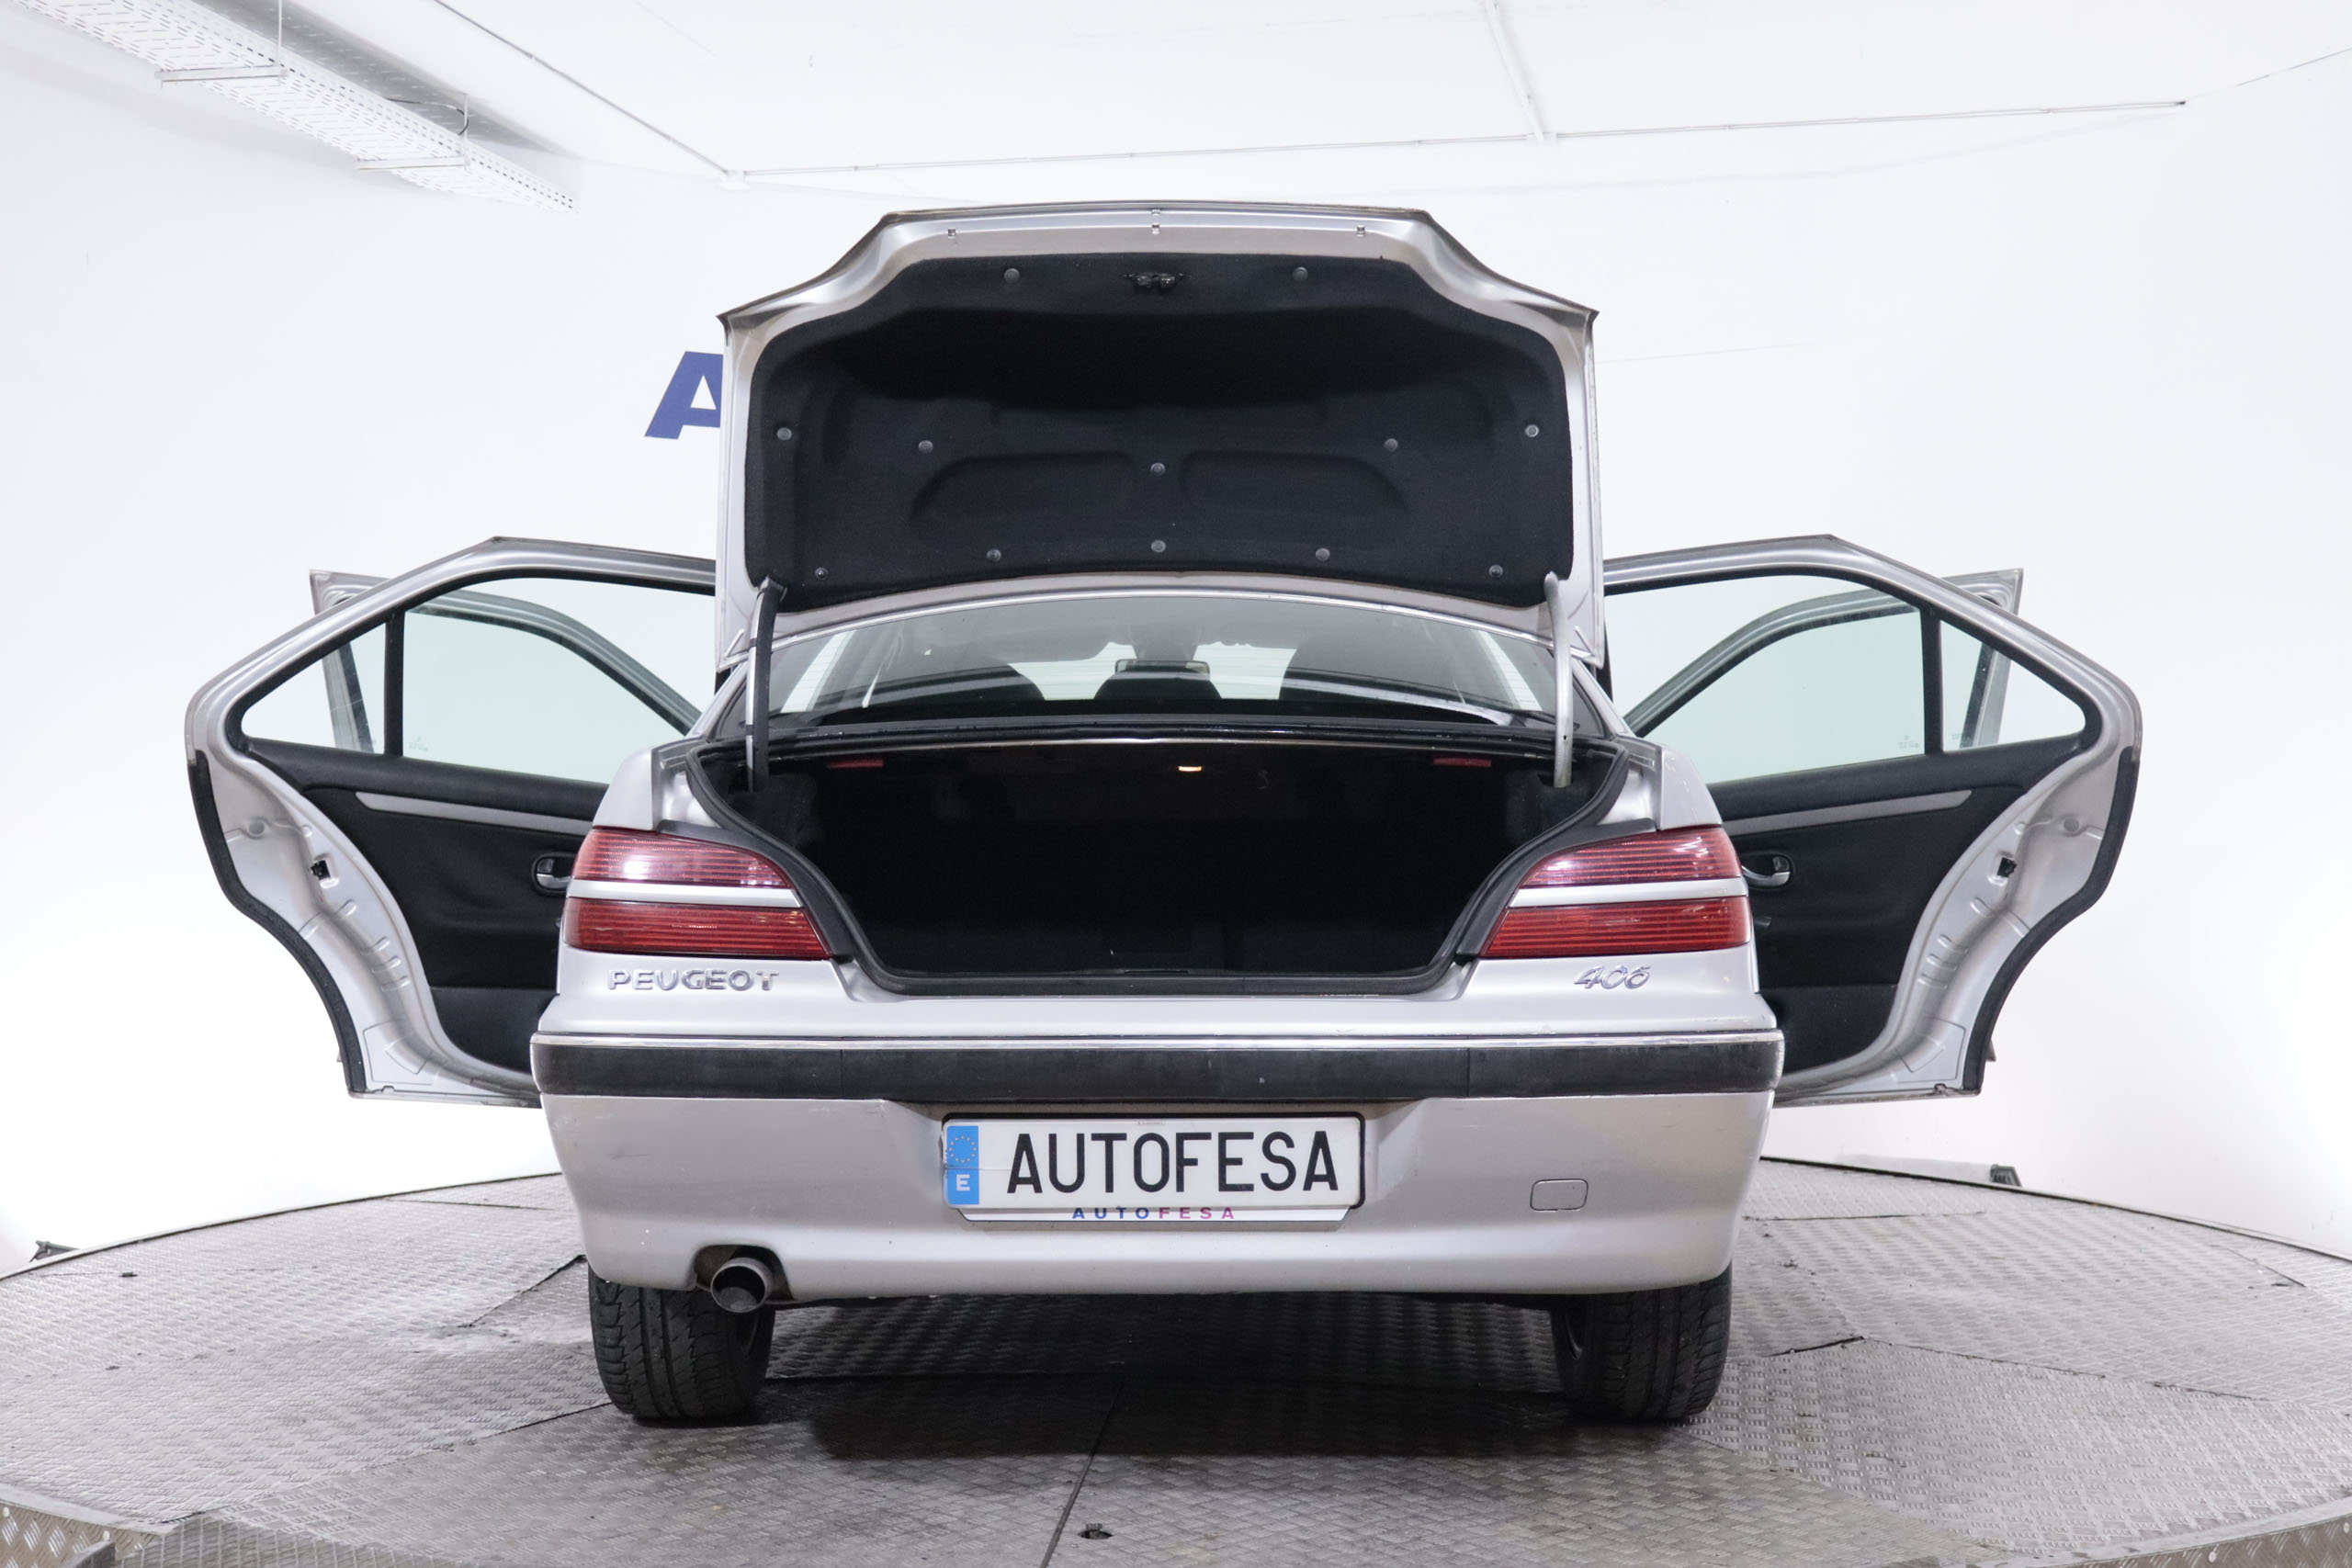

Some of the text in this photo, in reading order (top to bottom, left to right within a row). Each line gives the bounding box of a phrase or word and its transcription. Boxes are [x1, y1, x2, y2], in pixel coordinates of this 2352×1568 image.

[607, 969, 780, 991] PEUGEOT
[1574, 965, 1651, 989] 406
[1007, 1131, 1339, 1193] AUTOFESA
[956, 1174, 970, 1191] E
[1072, 1207, 1234, 1220] AUTOFESA
